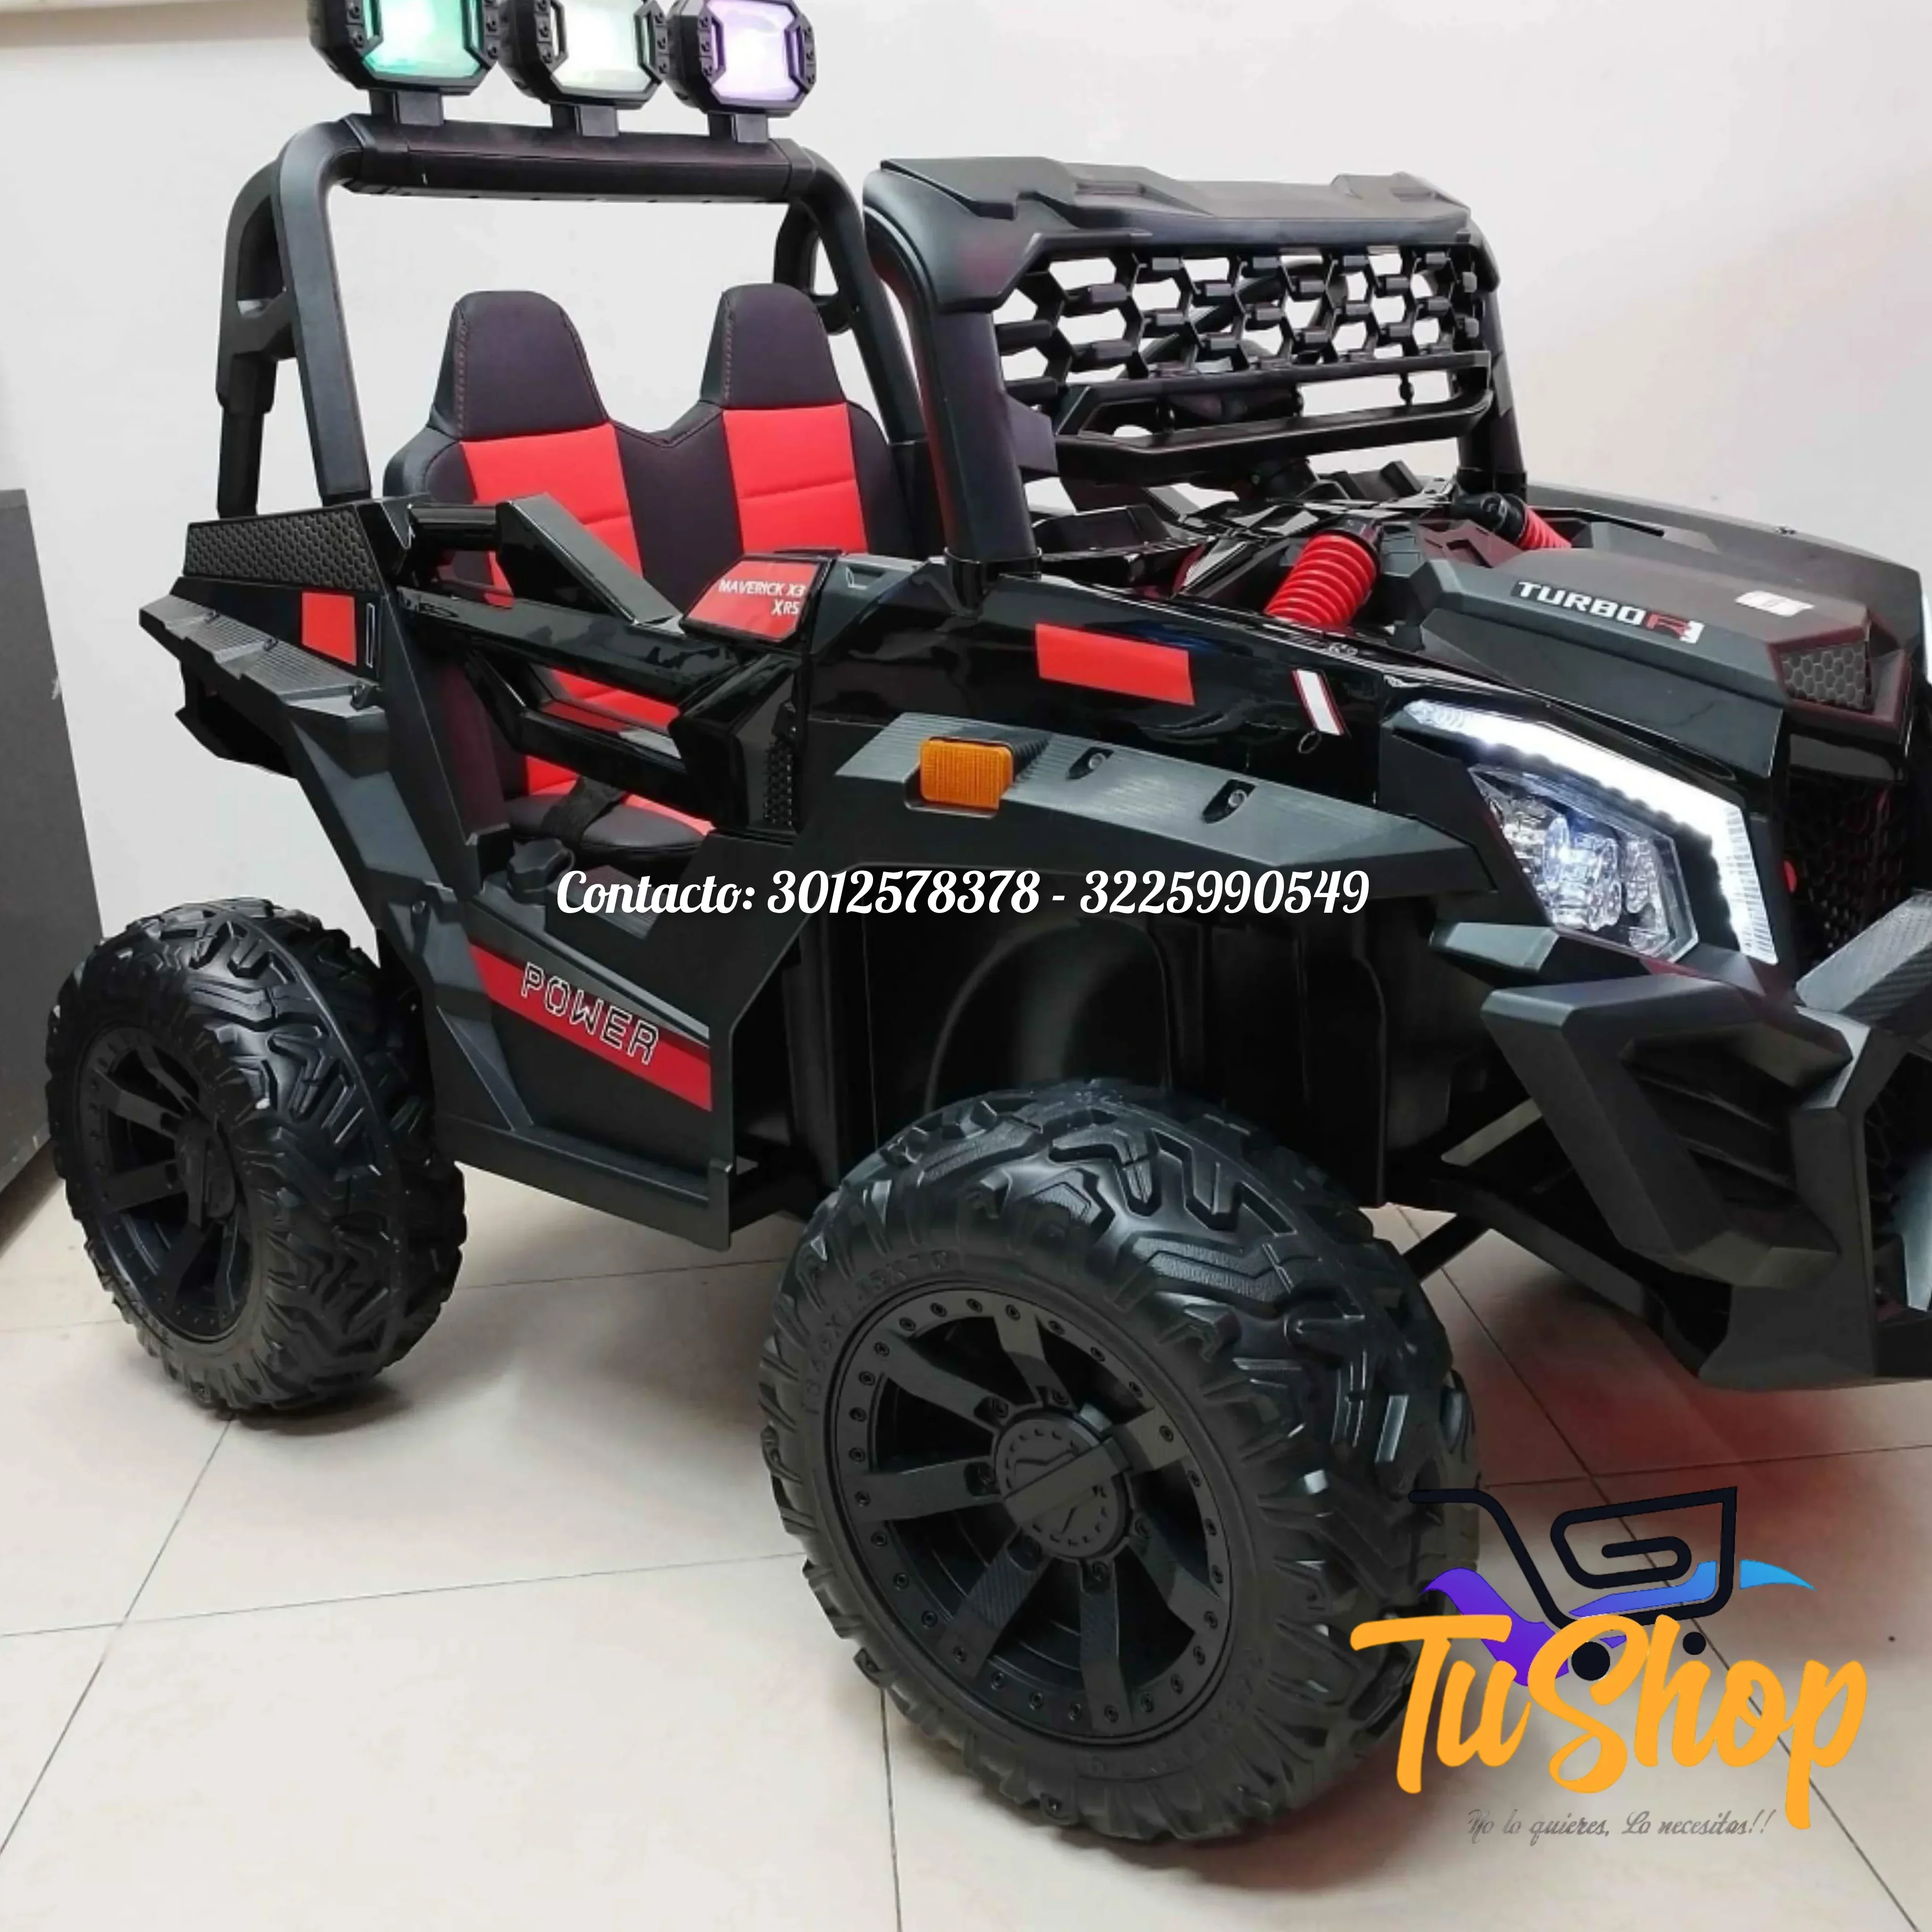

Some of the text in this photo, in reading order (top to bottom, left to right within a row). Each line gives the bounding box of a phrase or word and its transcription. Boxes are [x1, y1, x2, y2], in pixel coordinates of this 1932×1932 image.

[718, 579, 806, 597] MAVERICK X3
[521, 961, 658, 1066] POWER
